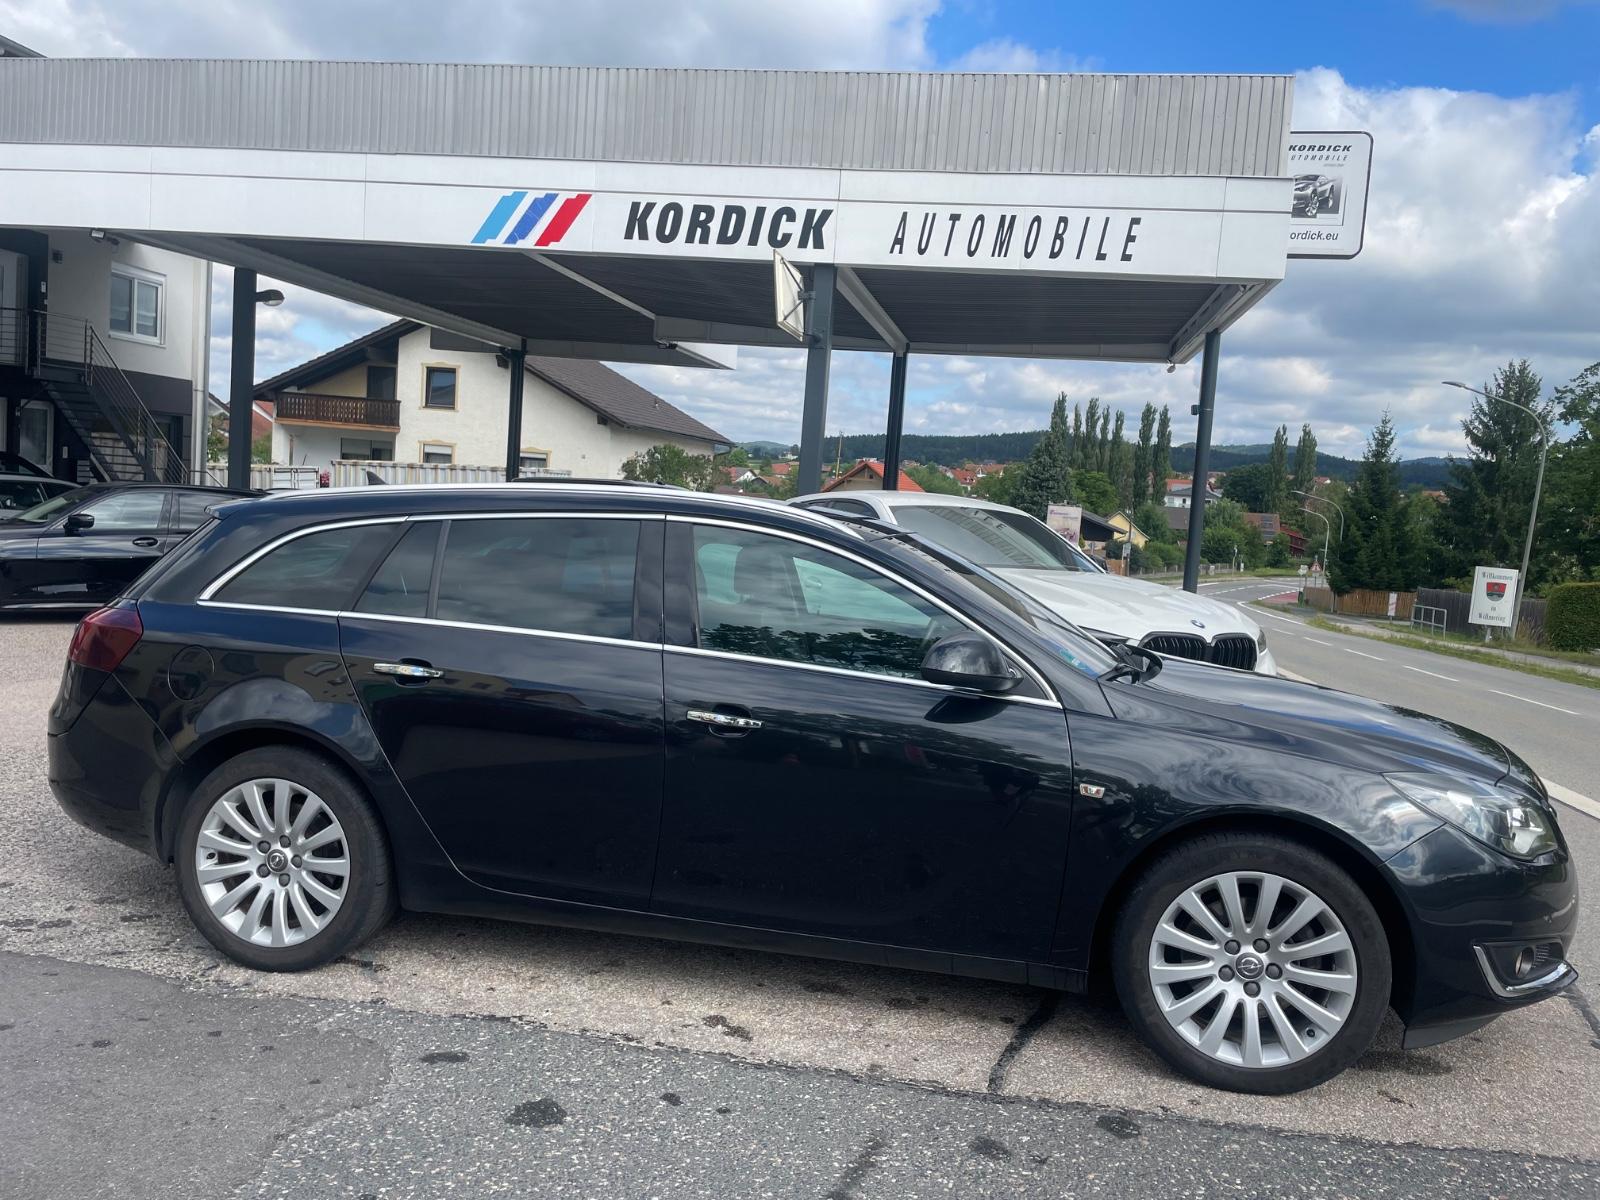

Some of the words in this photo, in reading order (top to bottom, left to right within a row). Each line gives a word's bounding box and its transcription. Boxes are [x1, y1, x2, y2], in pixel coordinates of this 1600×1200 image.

[1288, 144, 1353, 152] KORDICK
[623, 201, 834, 250] KORDICK
[889, 211, 1142, 262] AUTOMOBILE
